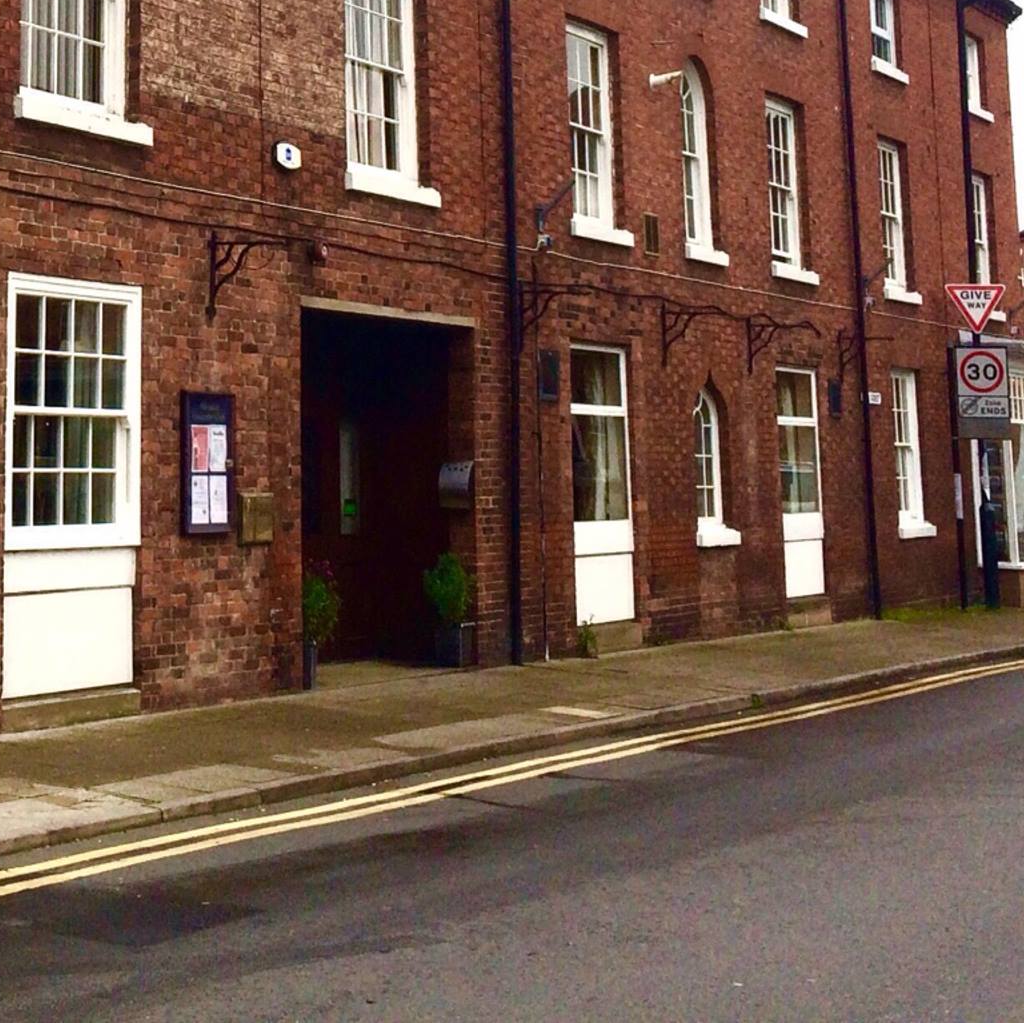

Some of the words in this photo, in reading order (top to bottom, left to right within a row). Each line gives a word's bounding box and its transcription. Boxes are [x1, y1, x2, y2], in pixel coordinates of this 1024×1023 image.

[960, 290, 992, 300] GIVE
[967, 363, 997, 381] 30
[980, 407, 1007, 415] ENDS
